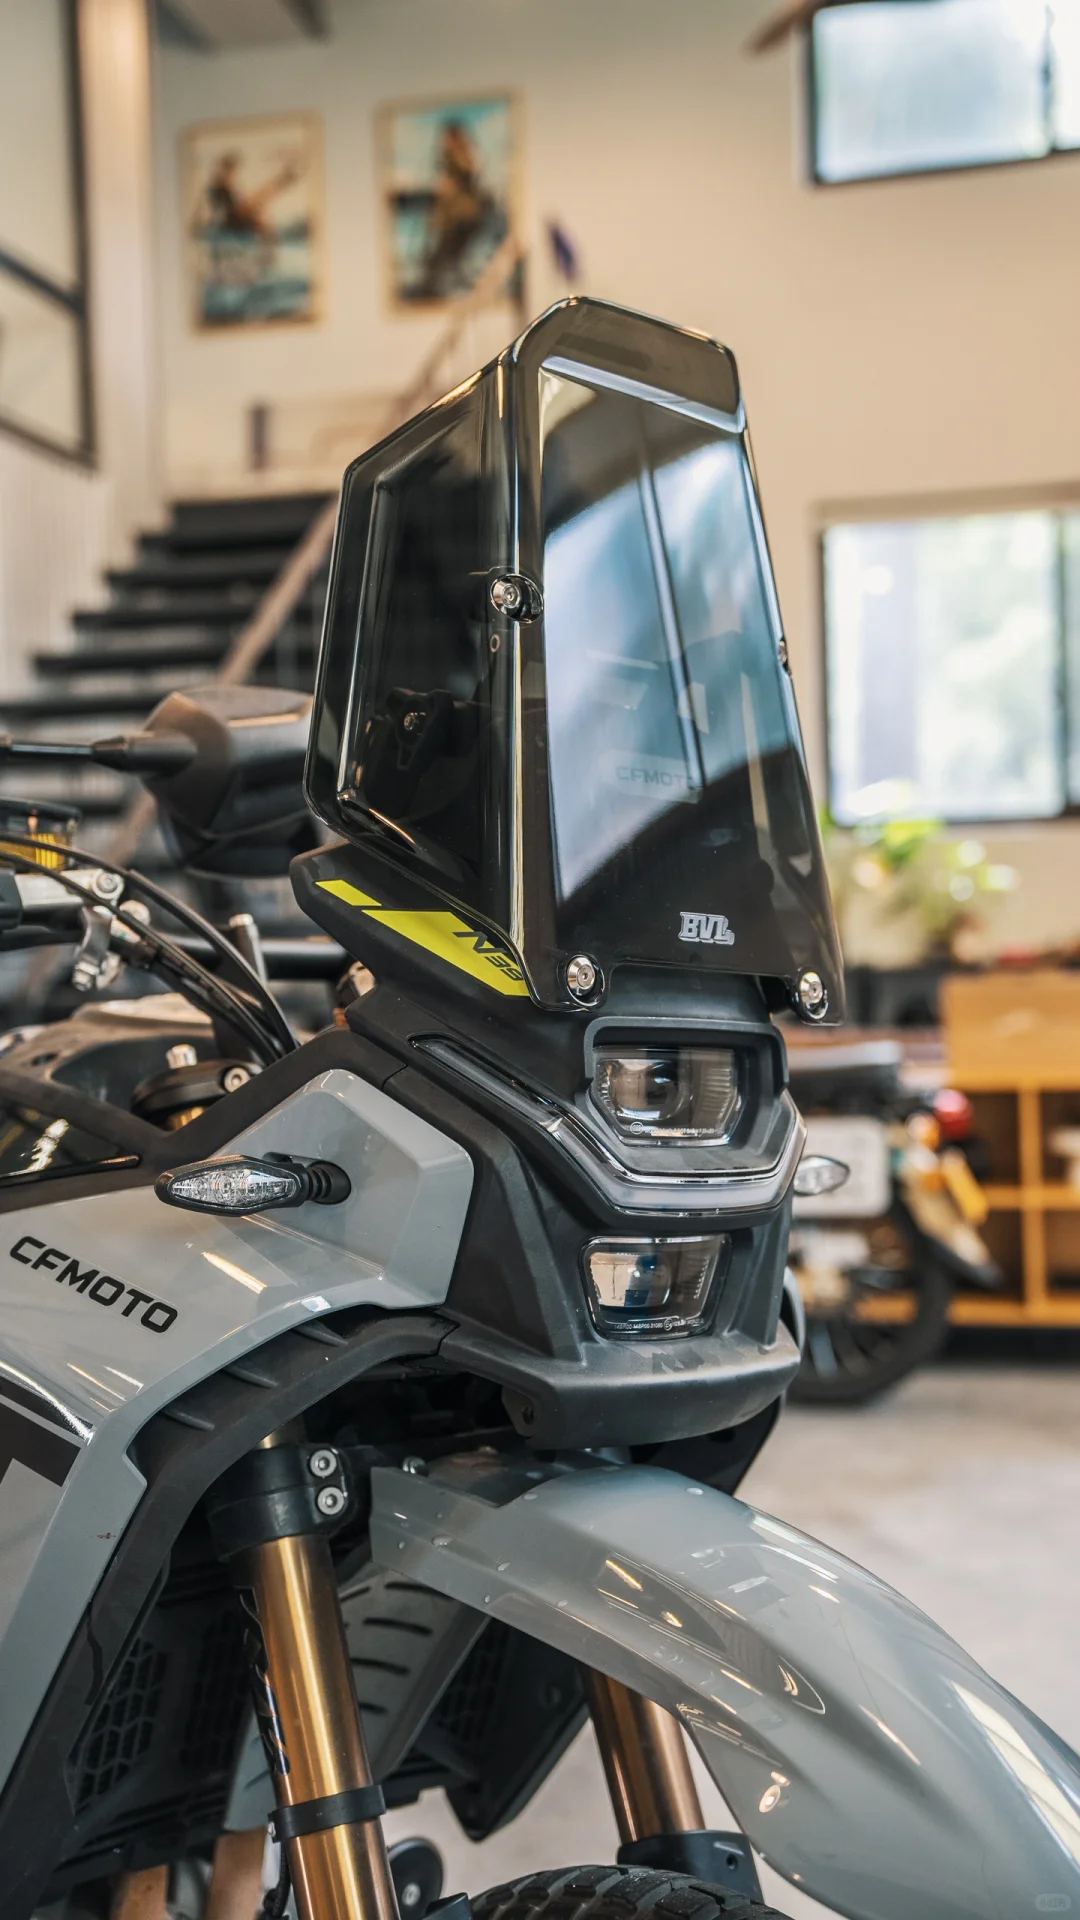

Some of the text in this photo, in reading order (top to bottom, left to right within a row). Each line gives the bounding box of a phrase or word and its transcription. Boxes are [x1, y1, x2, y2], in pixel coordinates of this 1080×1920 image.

[678, 911, 735, 945] BVL
[452, 931, 523, 981] N39
[10, 1236, 178, 1333] CFMOTO
